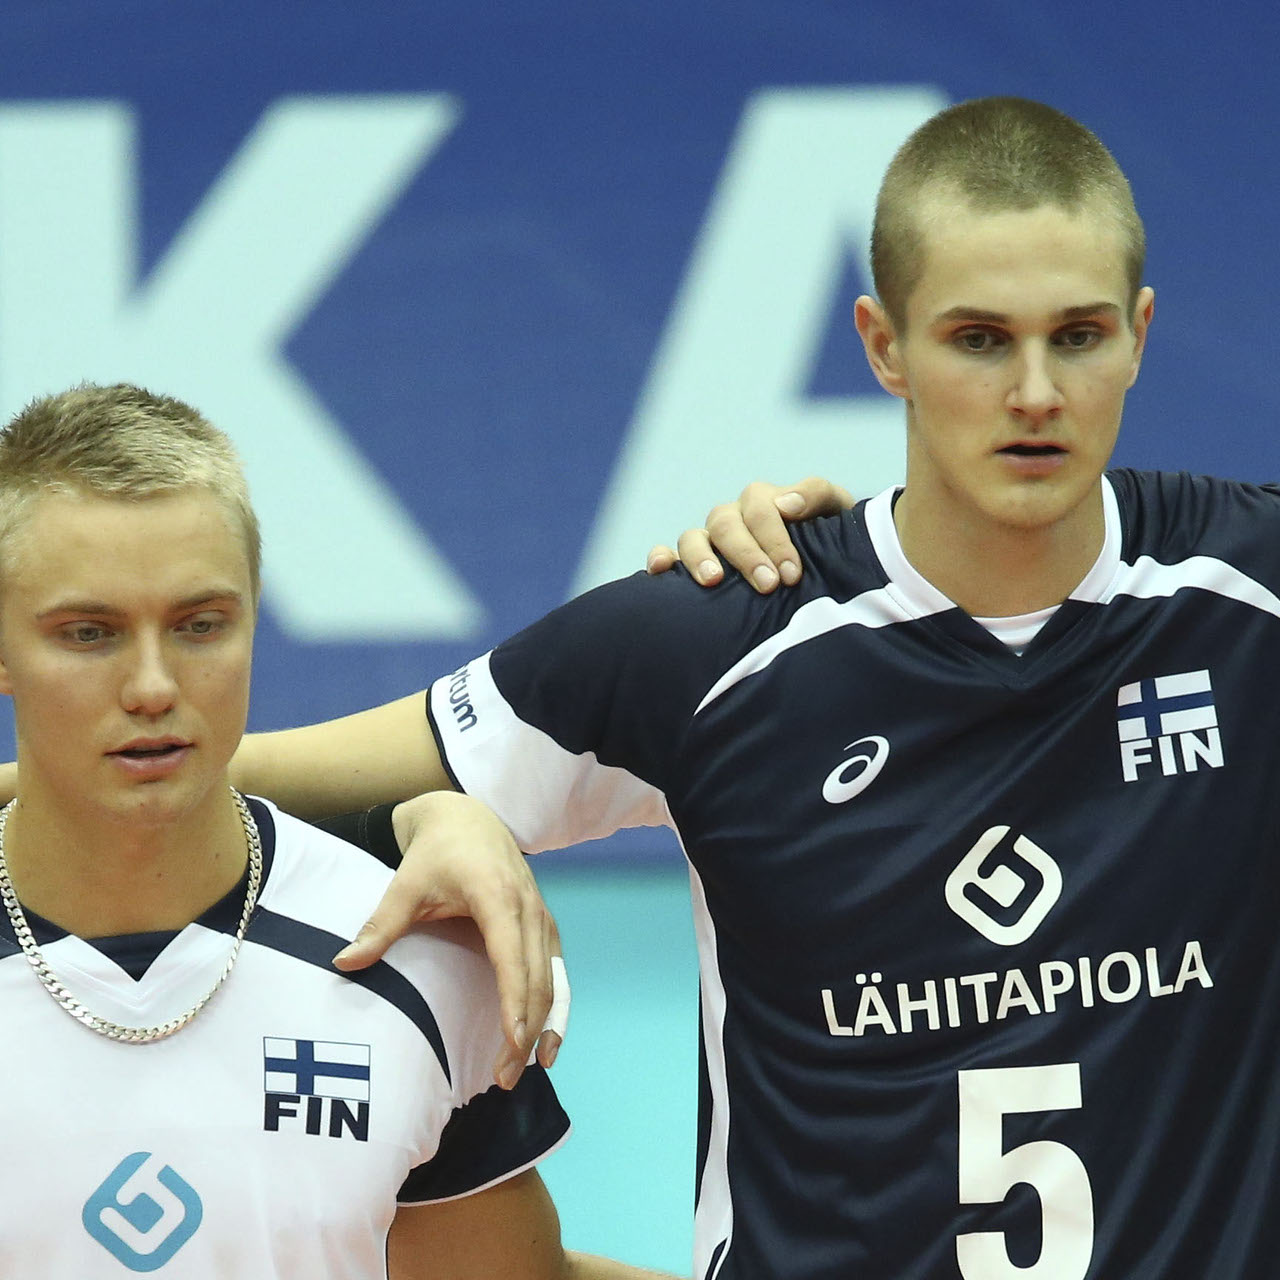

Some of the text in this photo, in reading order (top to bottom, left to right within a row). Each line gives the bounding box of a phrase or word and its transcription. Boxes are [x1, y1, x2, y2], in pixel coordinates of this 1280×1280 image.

[449, 669, 478, 733] rtum
[1120, 728, 1226, 783] FIN
[821, 940, 1214, 1037] LÄHITAPIOLA
[264, 1094, 370, 1142] FIN
